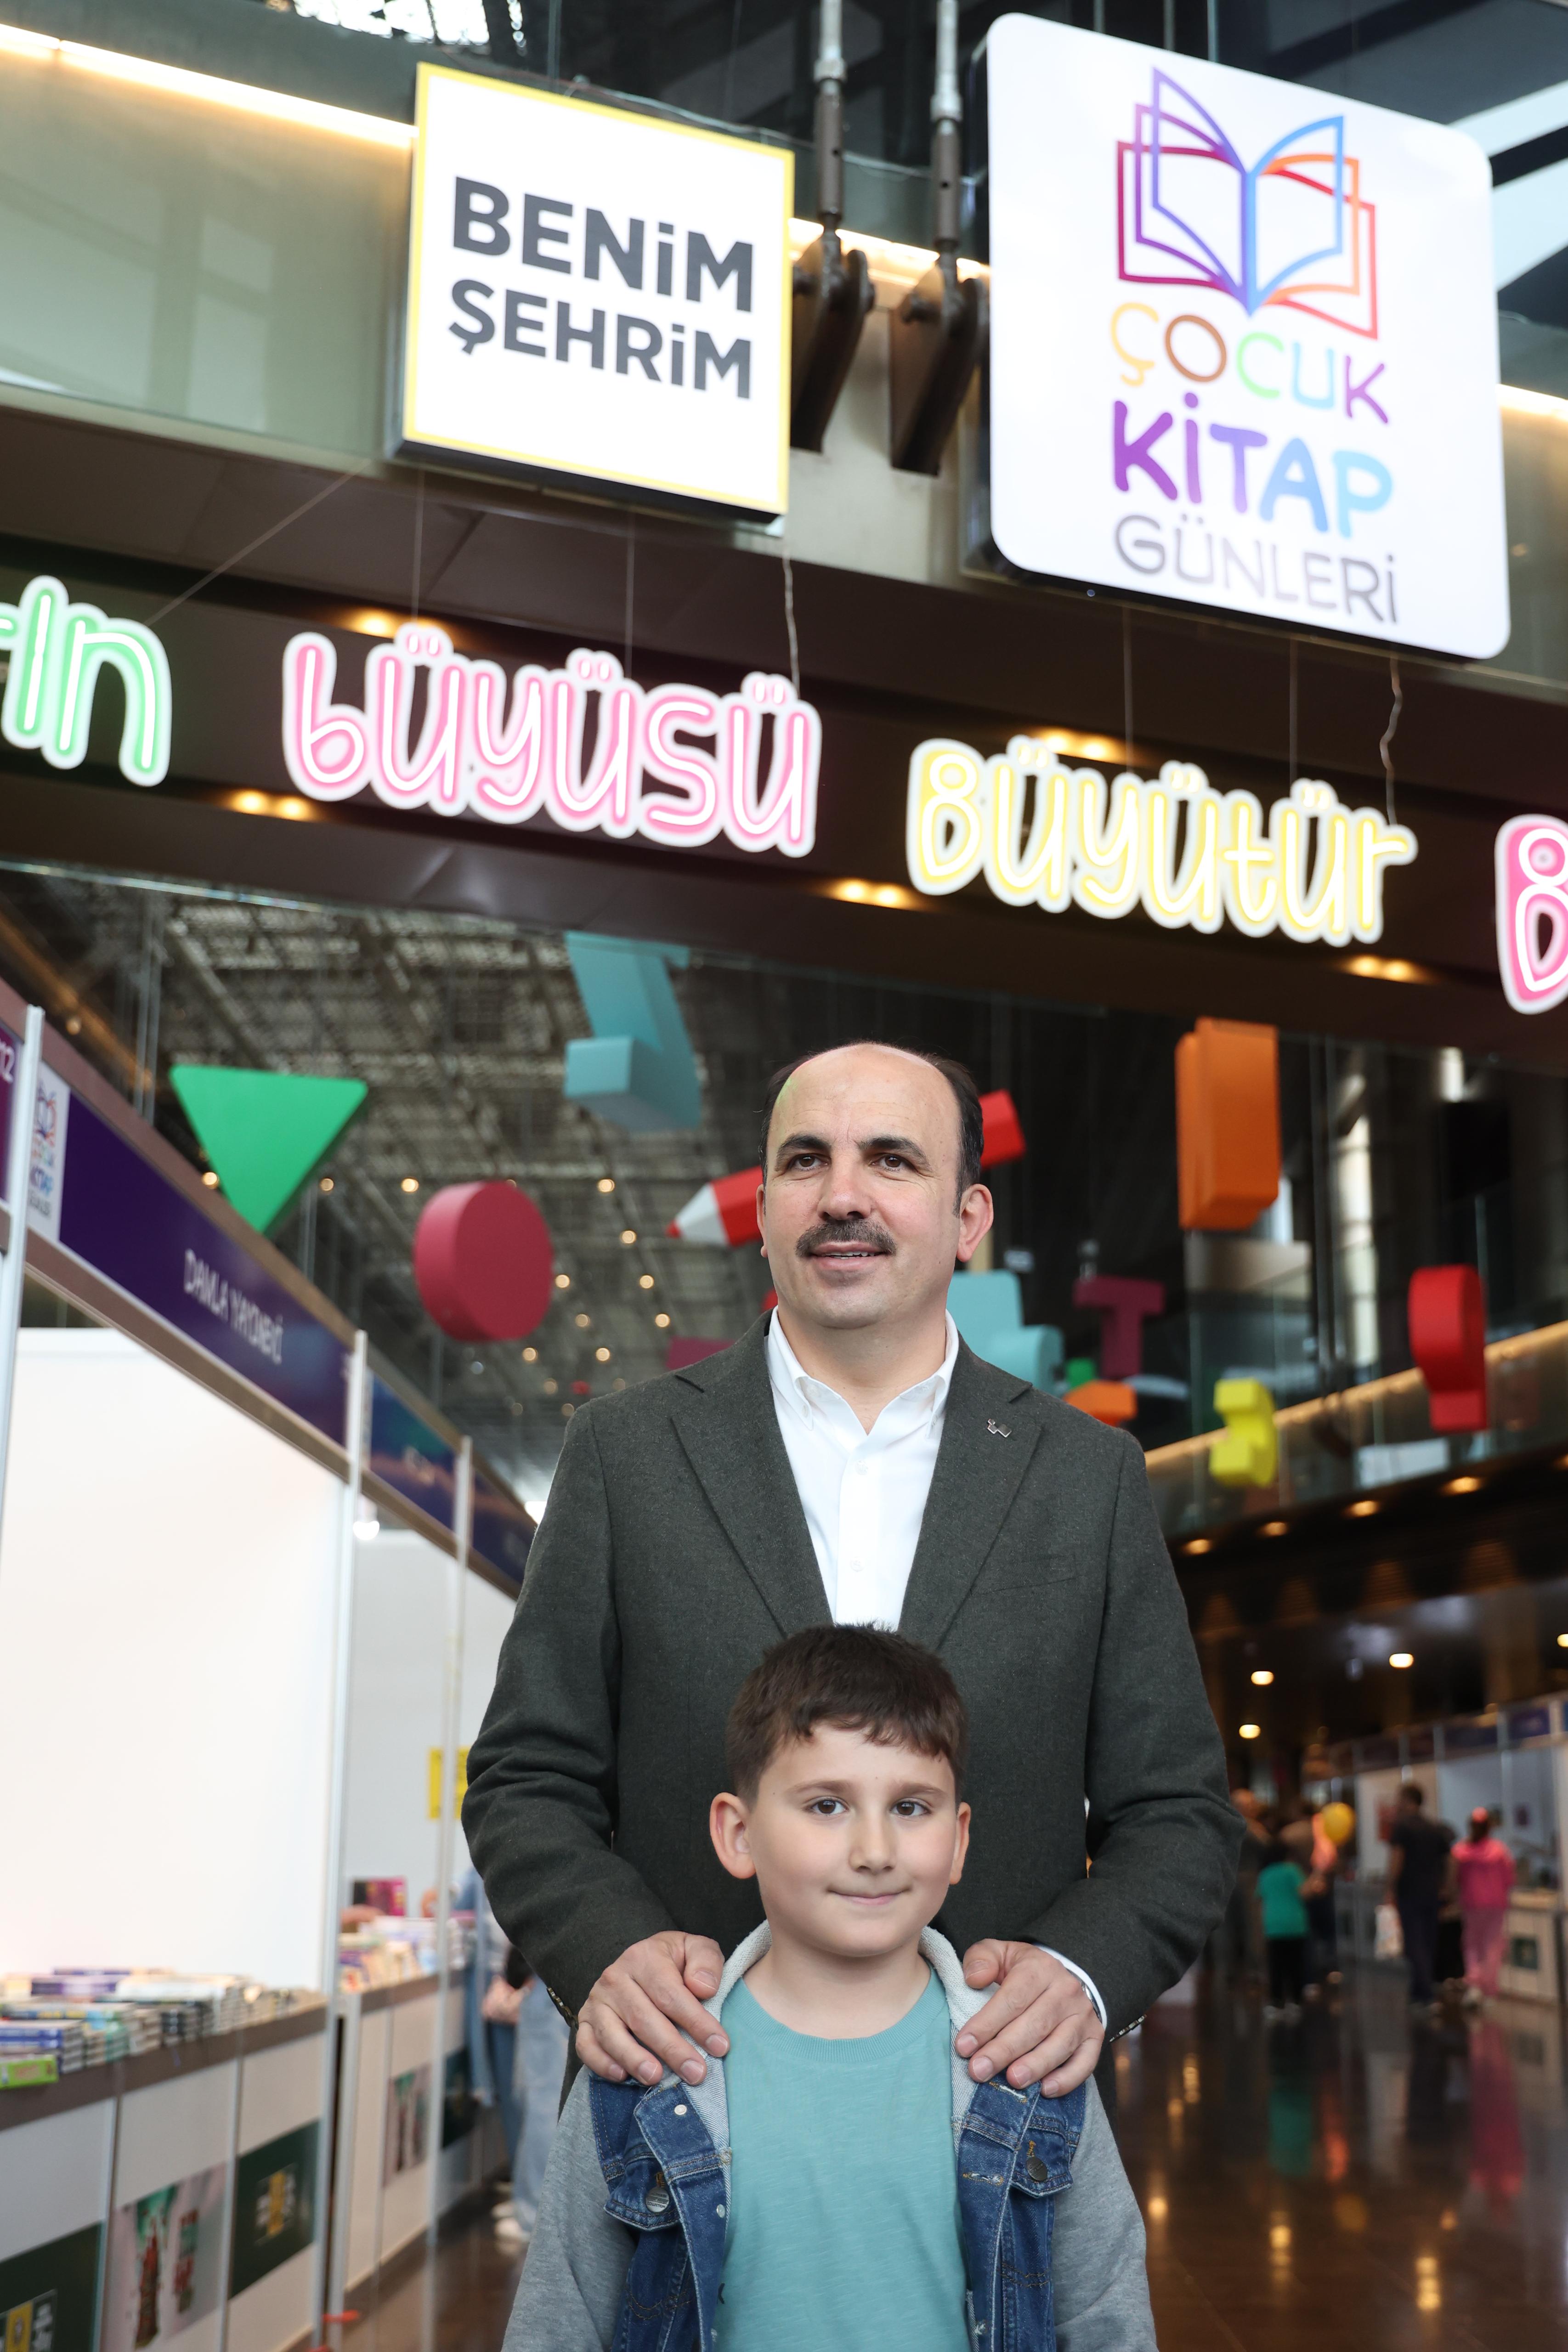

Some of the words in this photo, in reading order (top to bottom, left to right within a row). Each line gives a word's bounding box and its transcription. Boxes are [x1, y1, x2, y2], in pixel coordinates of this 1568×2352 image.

[1110, 302, 1389, 424] ÇOCUK
[1114, 392, 1393, 538] KİTAP
[1115, 514, 1398, 624] GÜNLERİ
[283, 623, 822, 858] büyüsü
[906, 735, 1417, 947] Büyütür
[184, 1248, 229, 1323] DAMLA
